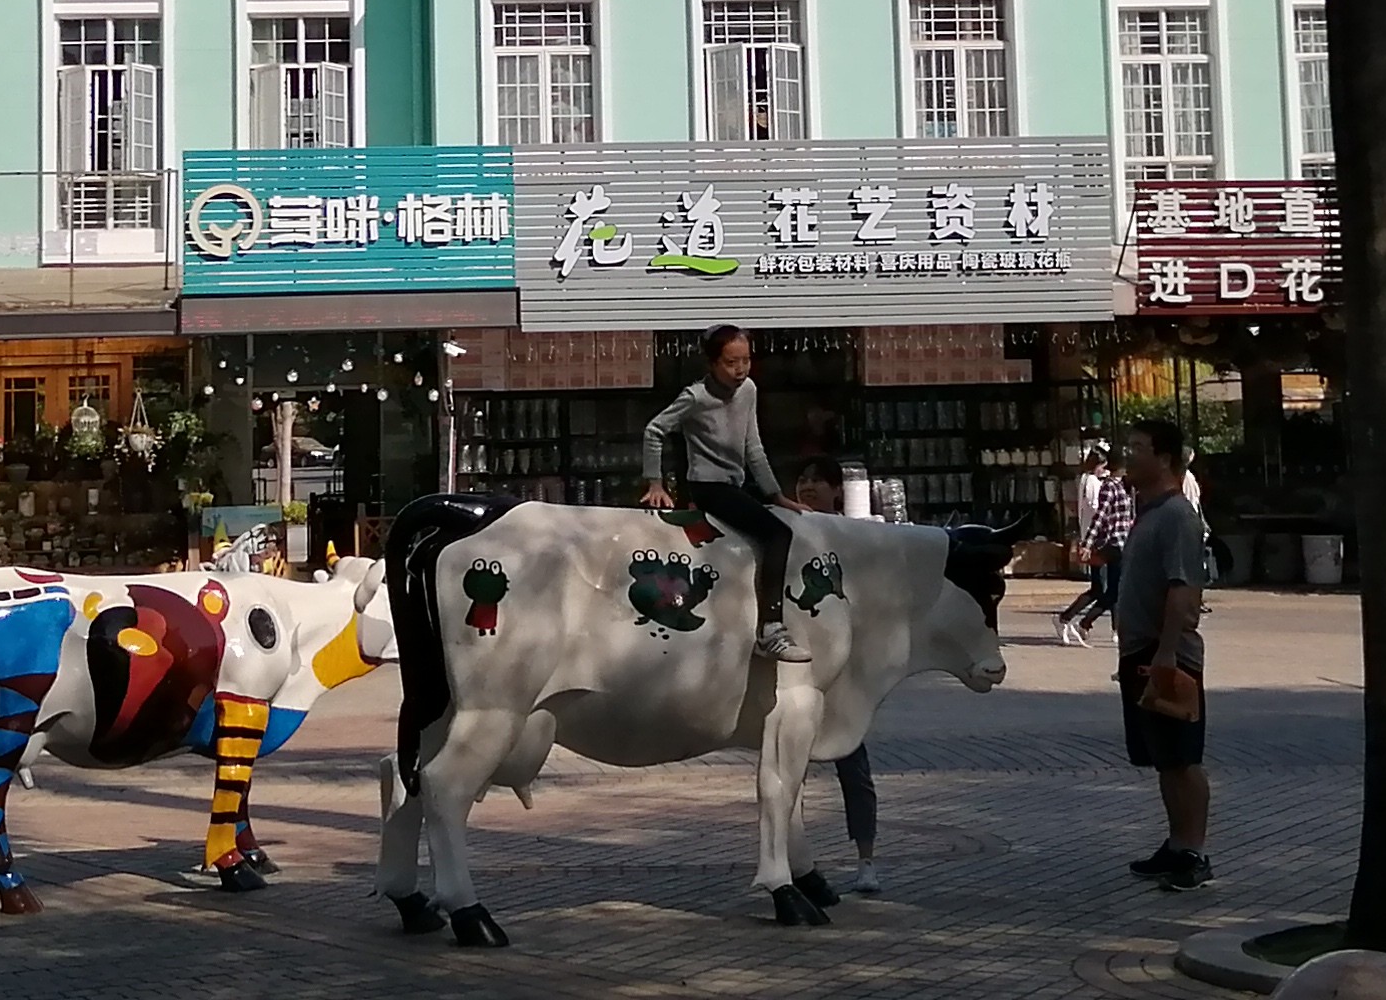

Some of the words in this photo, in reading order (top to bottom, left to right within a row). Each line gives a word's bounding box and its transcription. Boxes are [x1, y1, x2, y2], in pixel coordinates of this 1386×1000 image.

[554, 183, 741, 277] 花道
[772, 182, 1055, 243] 花艺资材
[1146, 188, 1322, 235] 基地直
